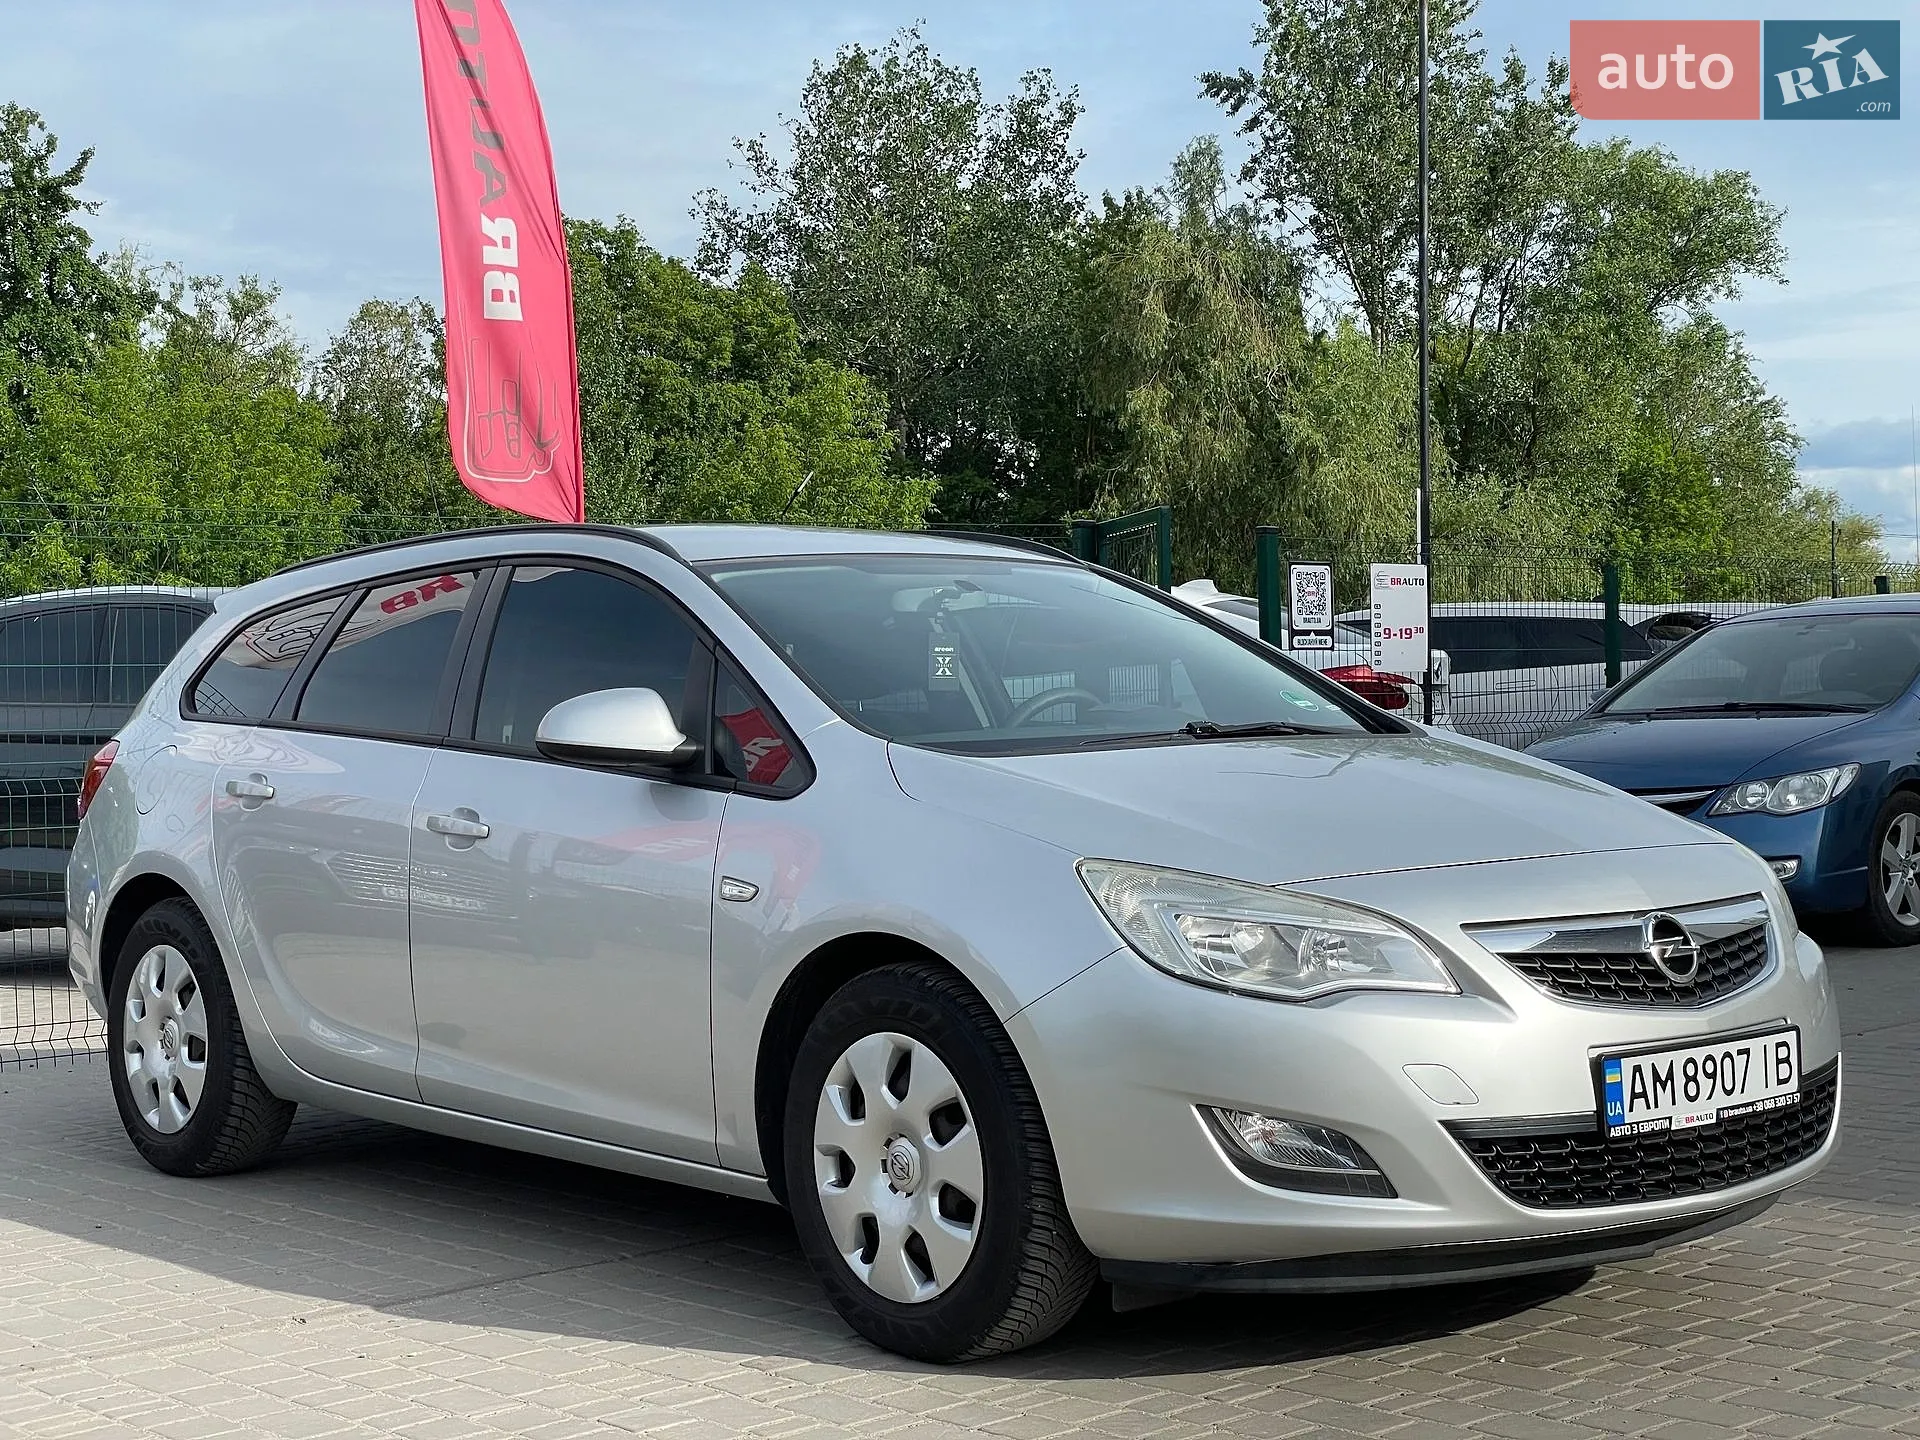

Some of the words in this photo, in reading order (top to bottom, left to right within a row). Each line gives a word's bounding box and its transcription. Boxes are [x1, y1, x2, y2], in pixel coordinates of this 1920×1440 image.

[1390, 577, 1425, 586] BRAUTO
[1628, 1059, 1677, 1113] AM
[1682, 1047, 1751, 1103] 8907
[1763, 1040, 1793, 1089] IB
[1607, 1101, 1623, 1117] UA
[1609, 1124, 1631, 1138] АВТО
